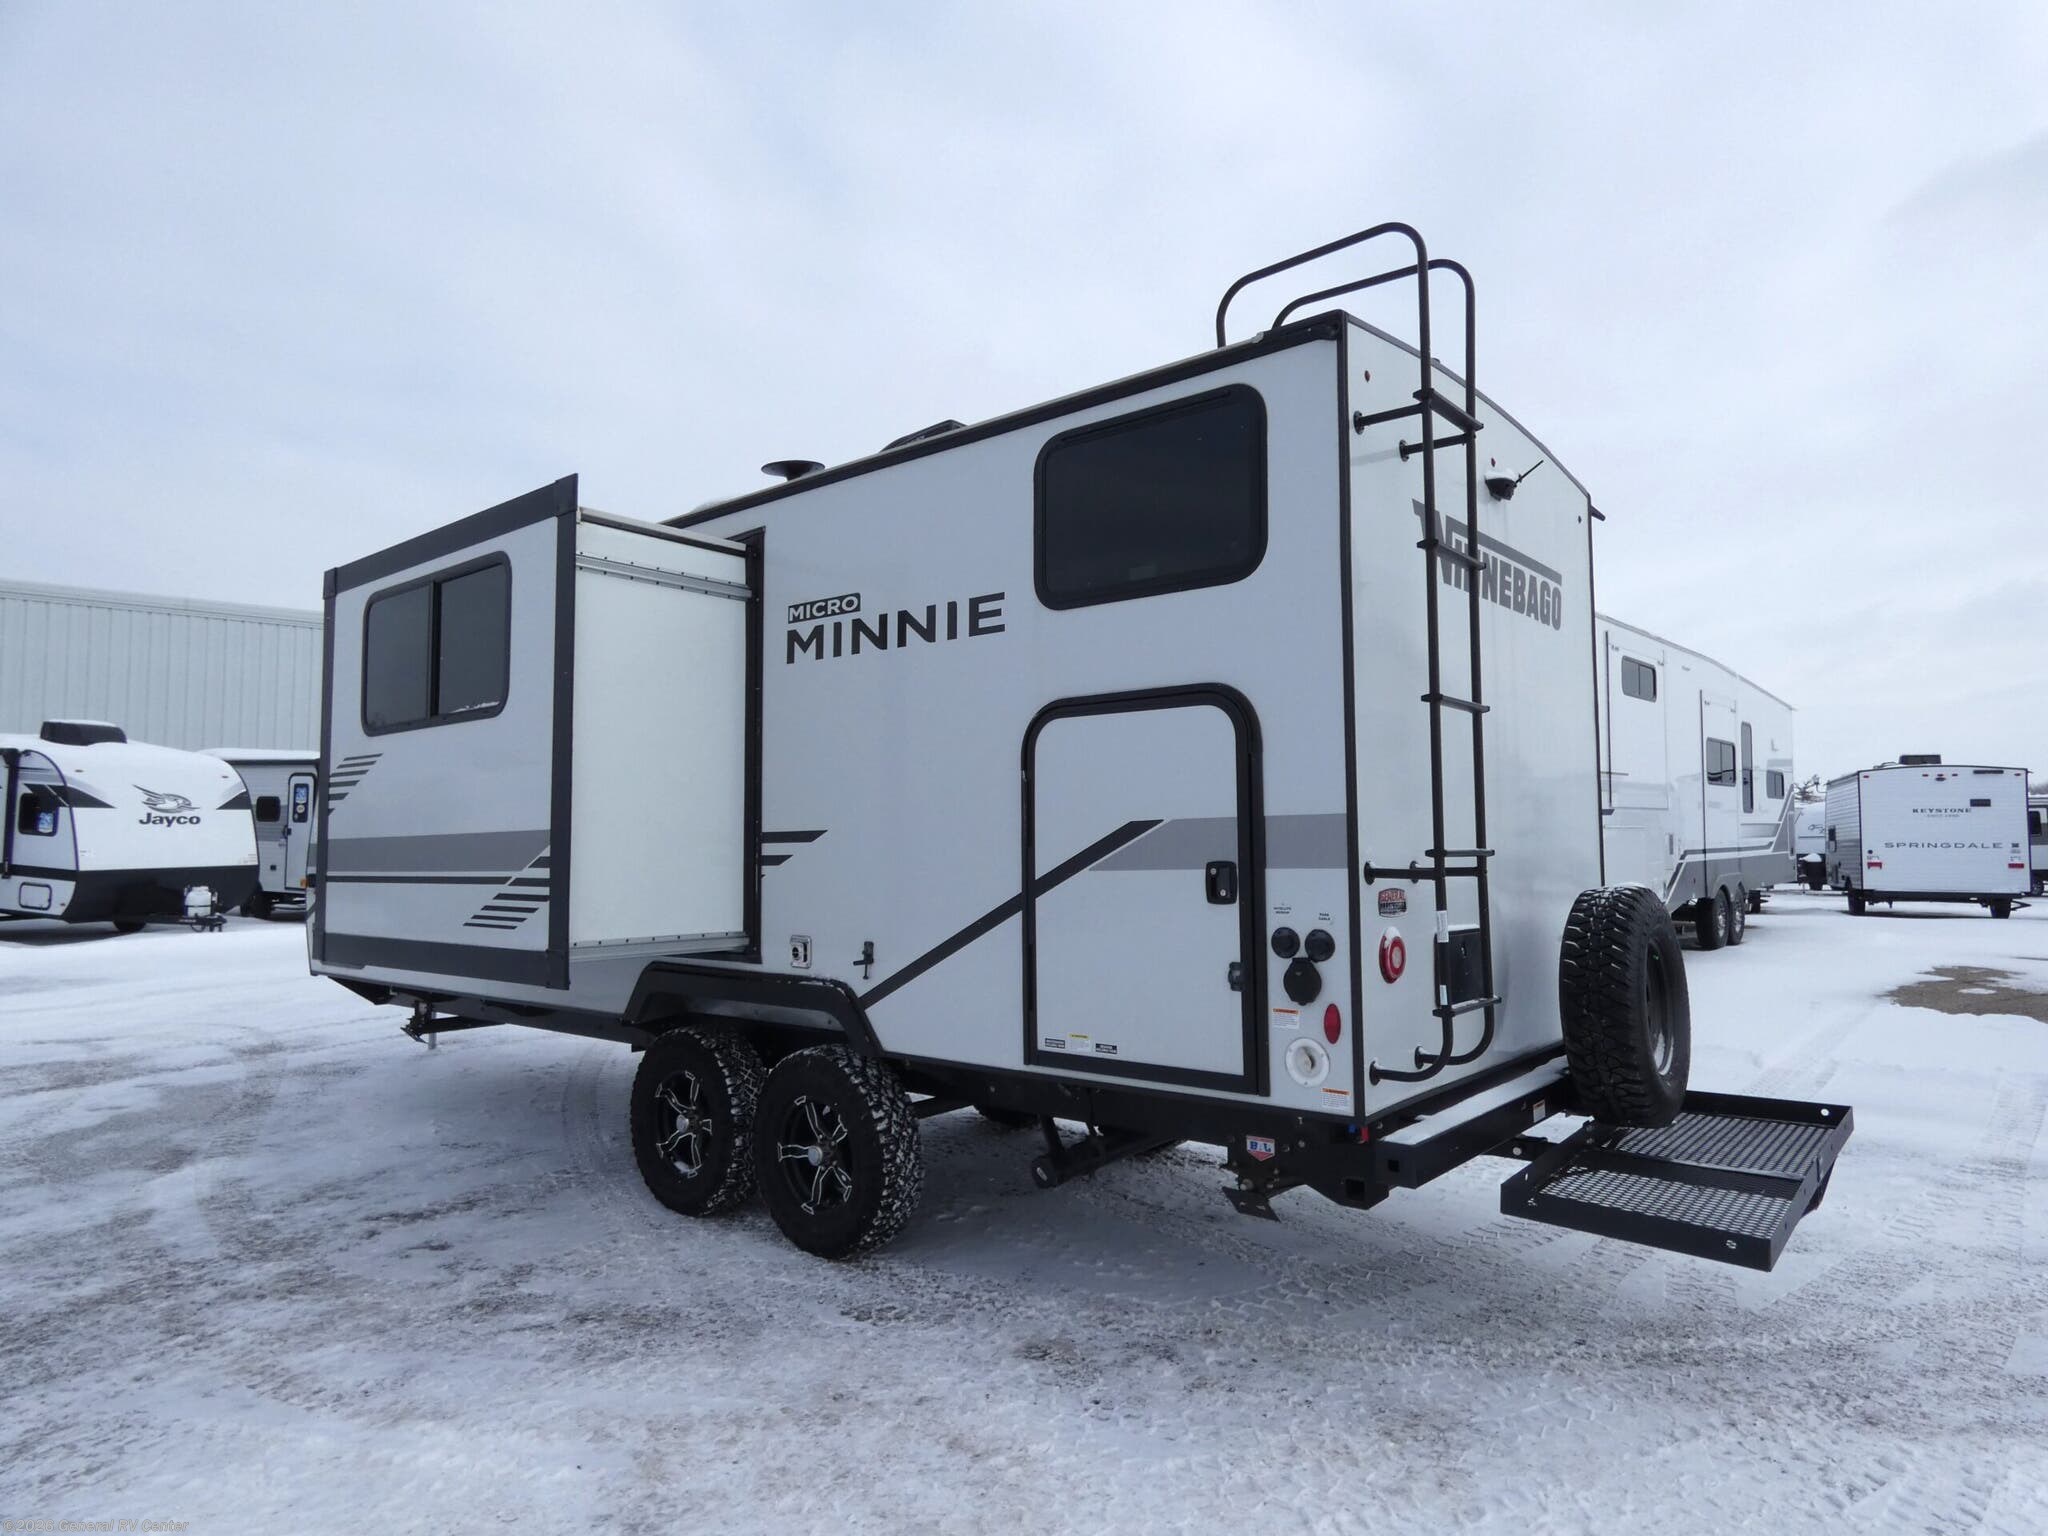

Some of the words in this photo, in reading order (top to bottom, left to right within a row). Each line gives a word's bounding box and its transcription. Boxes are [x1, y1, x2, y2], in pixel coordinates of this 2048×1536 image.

[788, 595, 859, 623] MICRO
[787, 592, 1005, 664] MINNIE
[138, 812, 201, 828] Jayco
